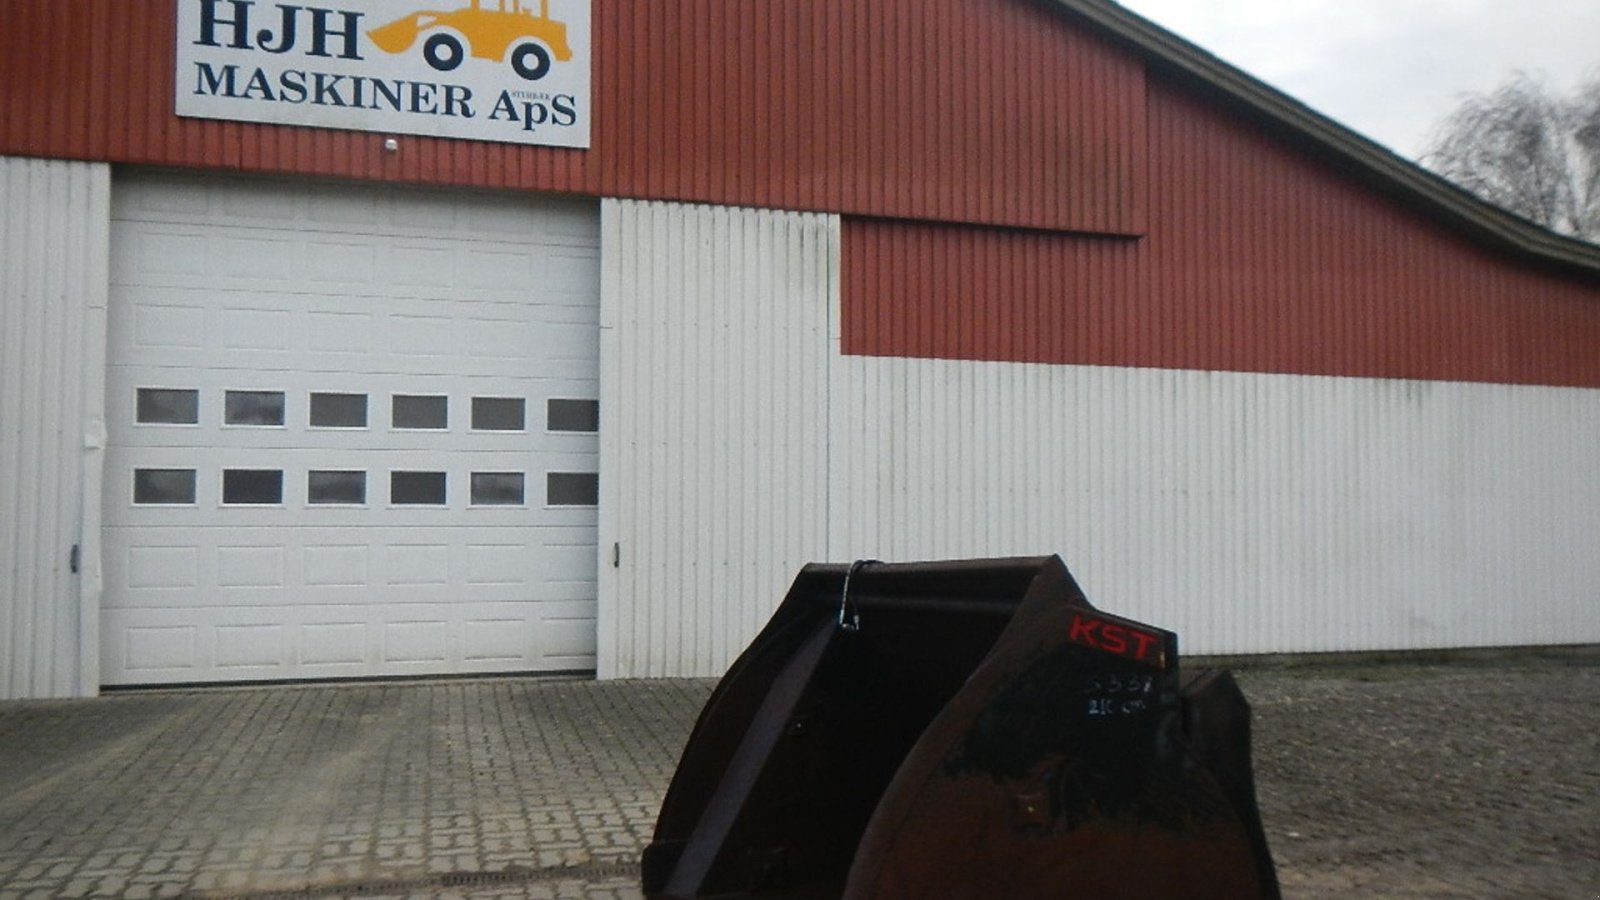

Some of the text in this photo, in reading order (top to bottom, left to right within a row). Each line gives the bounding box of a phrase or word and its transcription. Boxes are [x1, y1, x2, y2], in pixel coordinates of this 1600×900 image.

[193, 0, 365, 61] HJH
[193, 61, 576, 131] MASKINER ApS
[1069, 614, 1158, 660] KST
